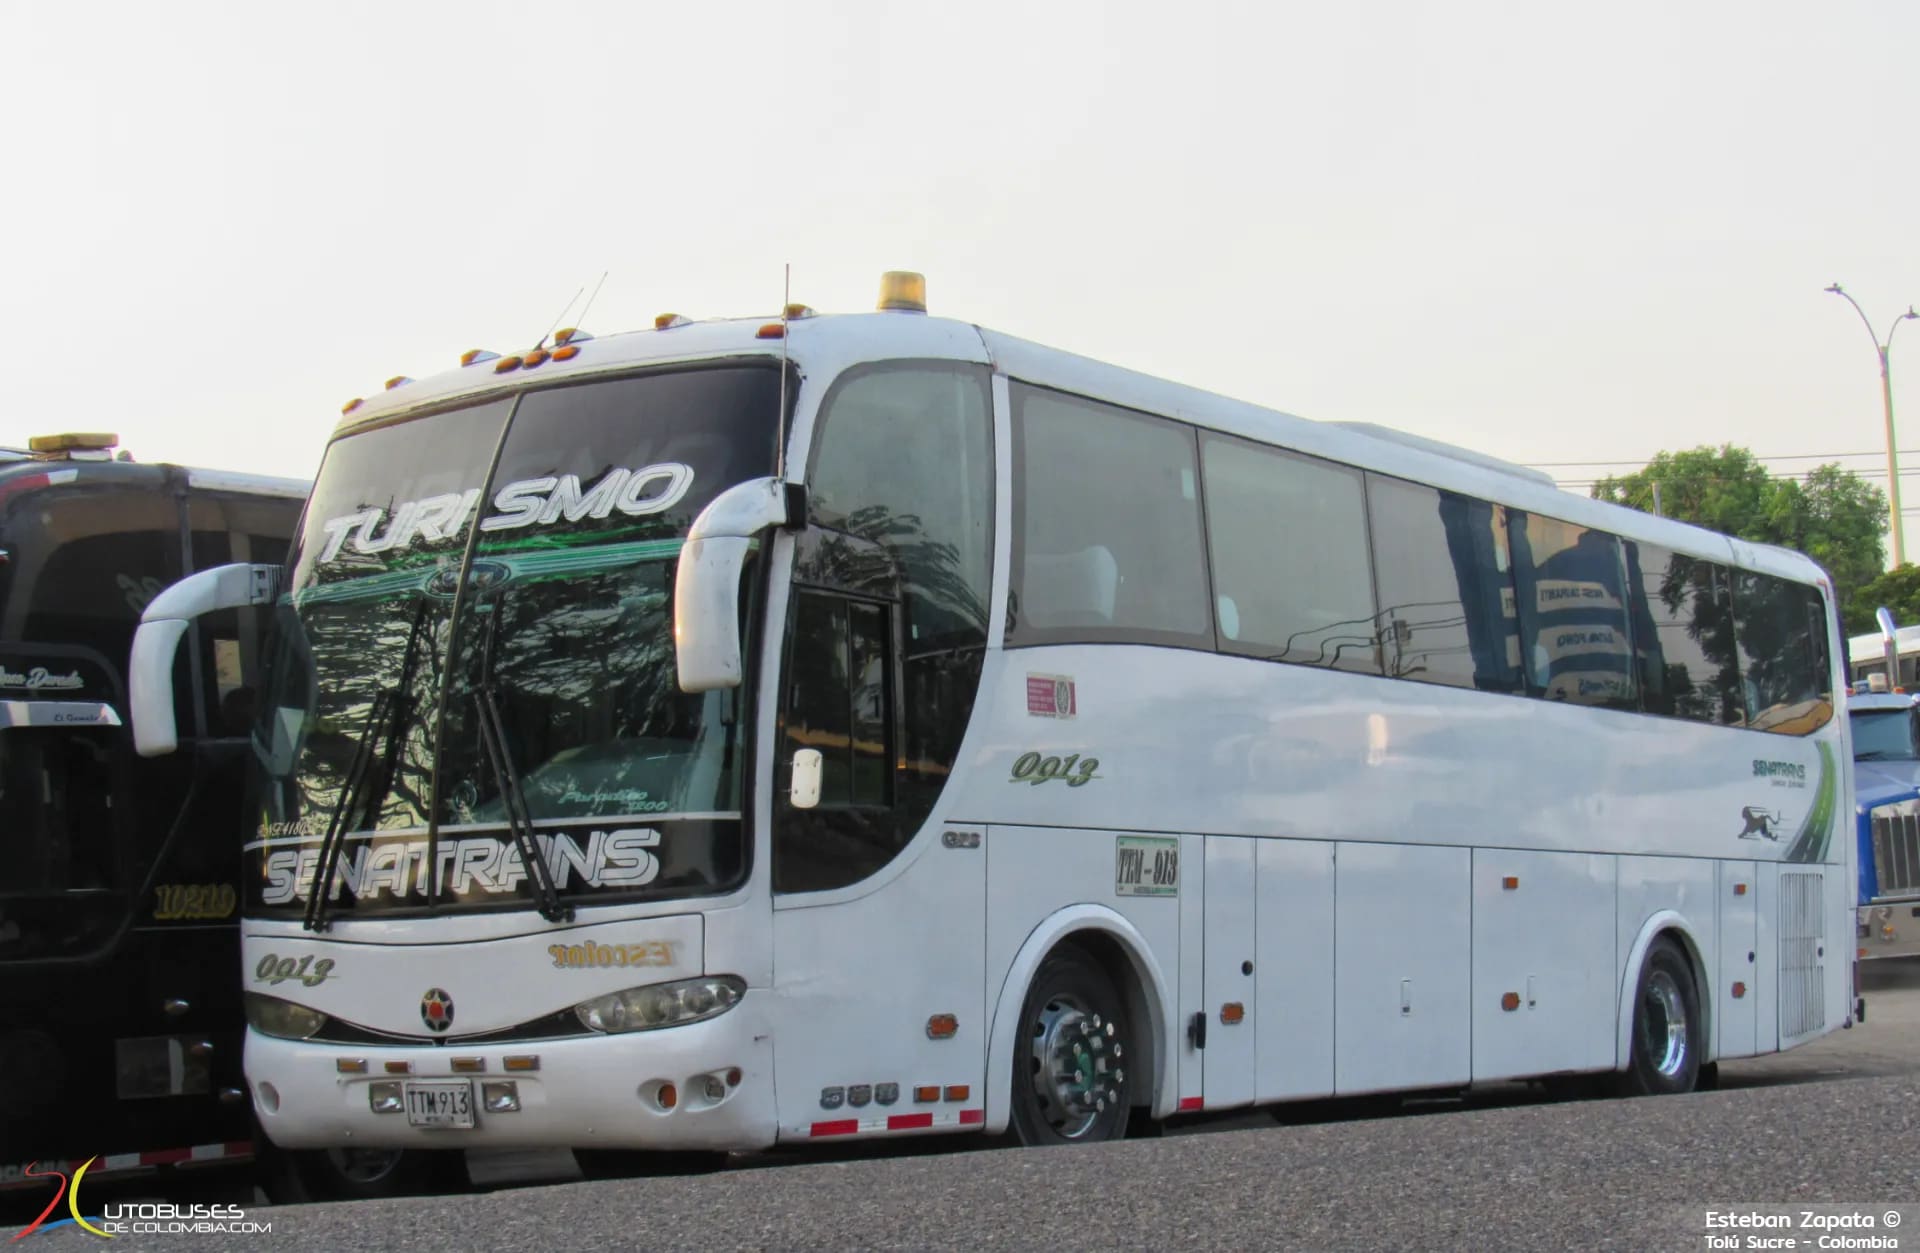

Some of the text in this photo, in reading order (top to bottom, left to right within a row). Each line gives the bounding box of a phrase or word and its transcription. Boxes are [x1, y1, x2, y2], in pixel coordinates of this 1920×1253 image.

[321, 462, 694, 563] TURISMO
[1010, 751, 1100, 787] 0913
[262, 828, 661, 904] SENATRANS
[255, 953, 336, 986] 0913
